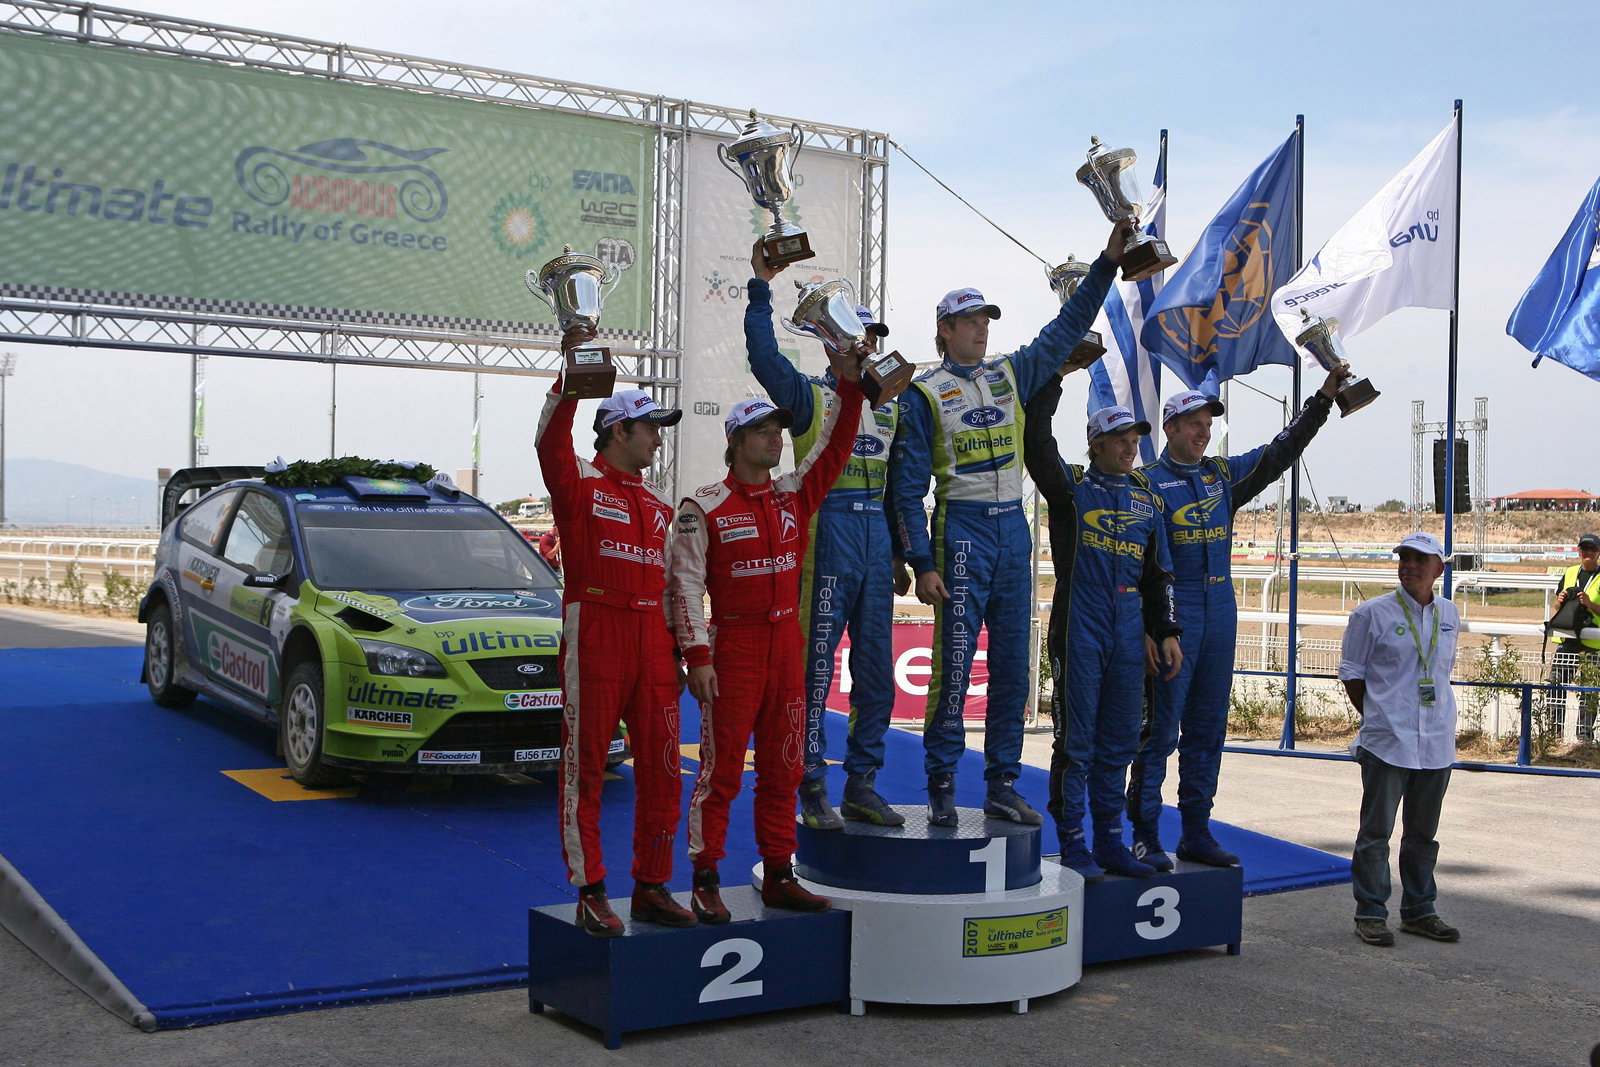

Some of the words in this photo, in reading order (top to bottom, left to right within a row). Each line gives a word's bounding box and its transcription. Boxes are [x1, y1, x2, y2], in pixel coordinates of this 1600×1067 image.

[528, 170, 552, 192] bp
[795, 173, 804, 190] p
[290, 174, 397, 218] ACROPOLIS
[581, 198, 637, 217] WRC
[232, 211, 306, 243] Rally
[313, 220, 343, 241] of
[350, 223, 447, 252] Greece
[971, 409, 997, 424] Ford
[957, 434, 1012, 453] ultimate
[842, 463, 885, 480] ltimate
[343, 505, 370, 513] Feel
[372, 505, 395, 513] the
[397, 505, 454, 514] difference
[603, 495, 625, 507] TOTAL
[595, 507, 628, 519] BFGoodrich
[723, 528, 756, 540] BFGoodrich
[1173, 525, 1227, 541] SUBARU
[599, 540, 664, 560] CITROË
[1082, 530, 1144, 556] SUBARU
[731, 552, 796, 570] CITROË
[954, 540, 971, 579] Feel
[434, 594, 528, 609] Ford
[818, 575, 837, 616] Feel
[952, 584, 968, 616] the
[434, 630, 455, 639] bp
[442, 630, 561, 656] ultima
[815, 620, 833, 655] the
[221, 642, 265, 693] Castrol
[524, 664, 537, 672] Ford
[947, 621, 967, 715] difference
[348, 672, 359, 684] bp
[347, 682, 457, 710] ultimate
[808, 656, 833, 754] difference
[354, 708, 412, 724] KÄRCHER
[566, 703, 577, 787] CITROËN
[421, 752, 478, 760] BFGoodrich
[516, 751, 539, 761] EJ56
[541, 749, 559, 759] FZV
[969, 836, 1007, 893] 1
[1134, 885, 1181, 940] 3
[966, 921, 978, 955] 2007
[988, 928, 1034, 941] ultimate
[698, 937, 764, 1003] 2
